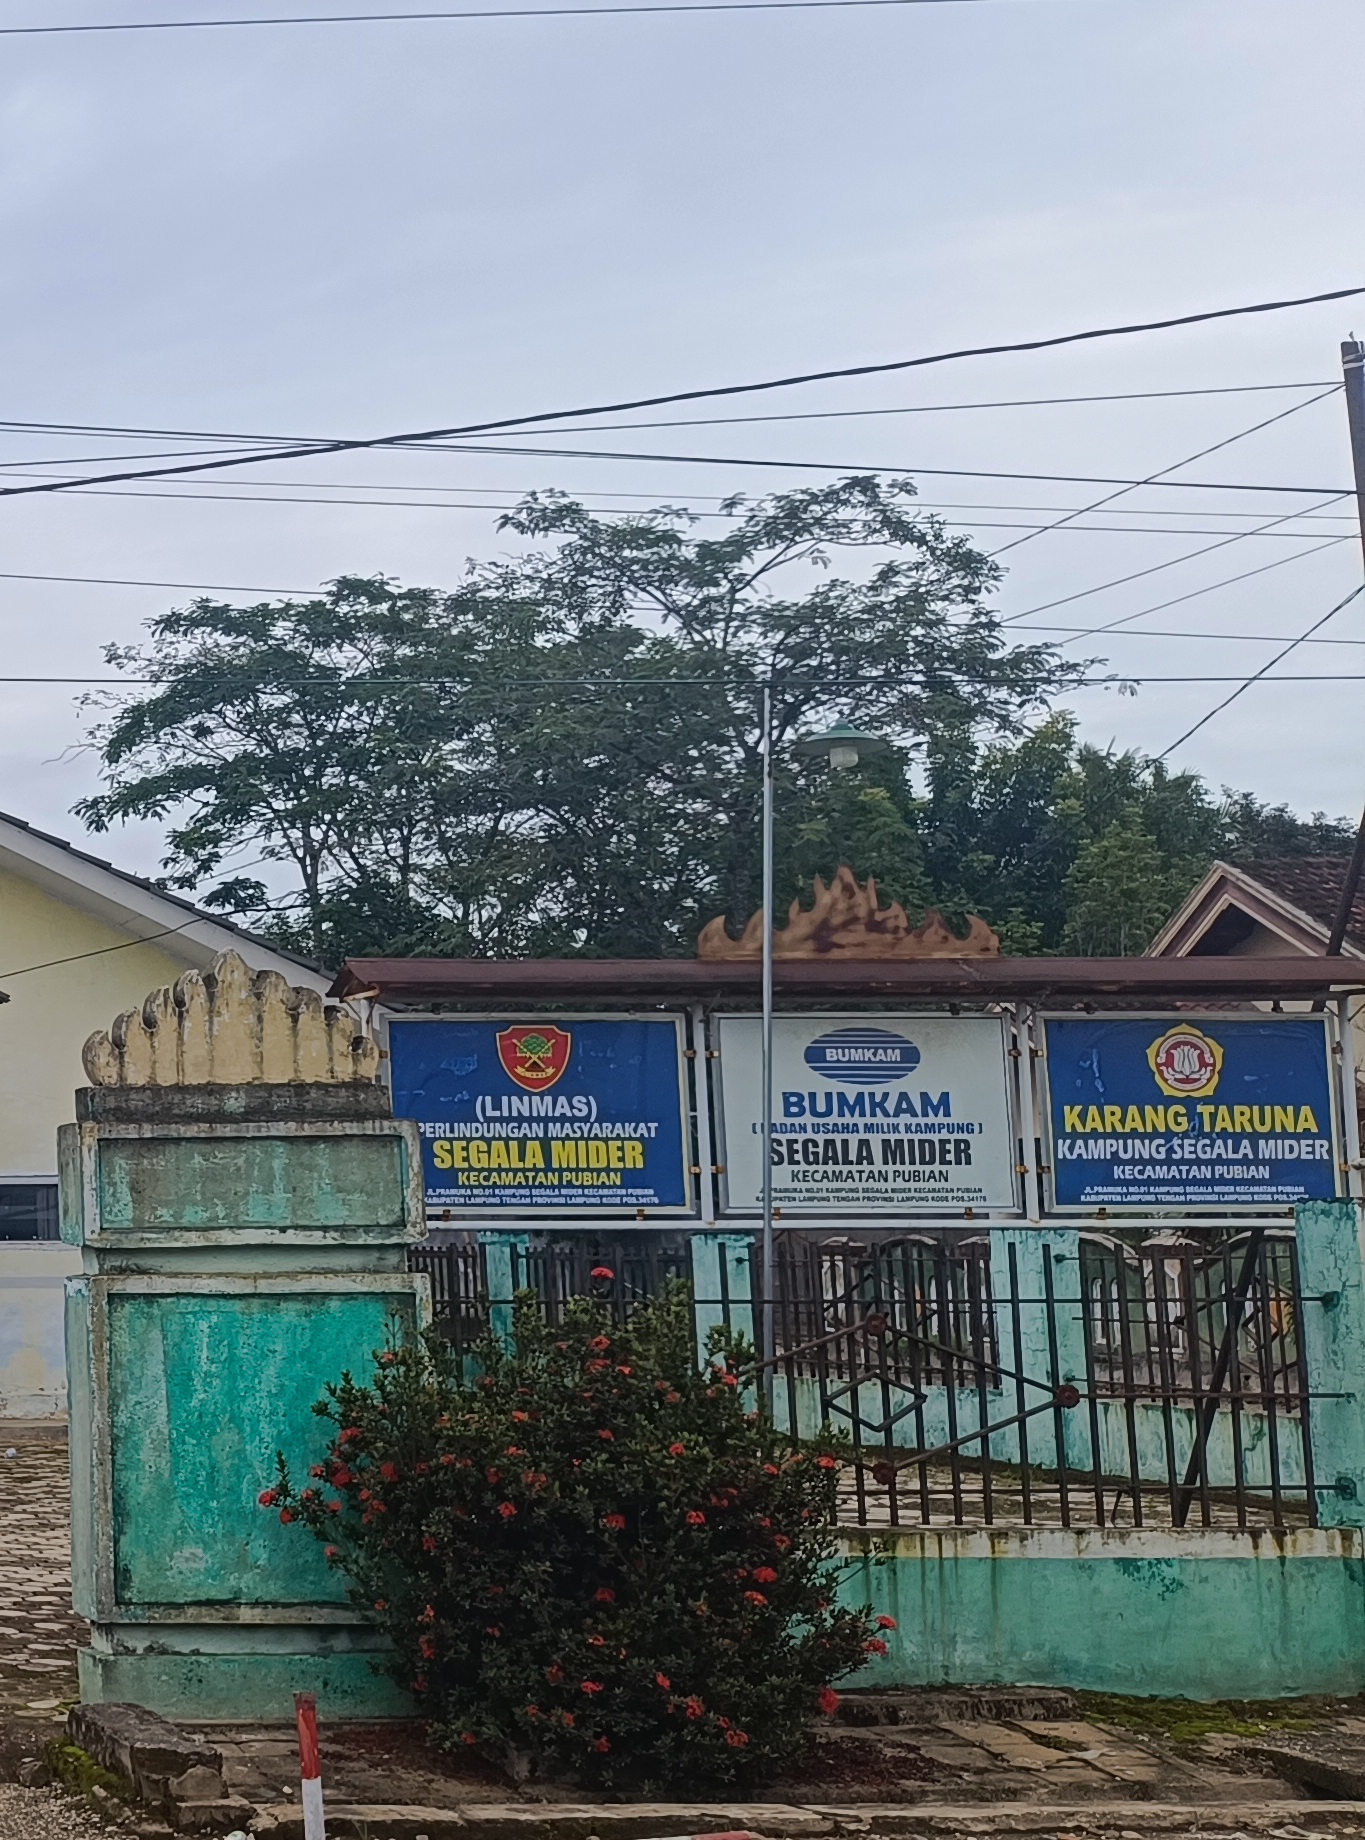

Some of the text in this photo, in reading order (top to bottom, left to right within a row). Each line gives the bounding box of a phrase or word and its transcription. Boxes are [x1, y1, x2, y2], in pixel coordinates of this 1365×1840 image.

[825, 1049, 901, 1061] BUMKAM
[476, 1095, 597, 1122] (LINMAS)
[782, 1092, 951, 1118] BUMKAM
[1064, 1105, 1318, 1133] KARANG TARUNA
[547, 1123, 658, 1137] MASYARAKAT
[811, 1123, 859, 1134] USAHA
[864, 1123, 901, 1134] MILIK
[904, 1123, 974, 1134] KAMPUNG
[433, 1140, 644, 1169] SEGALA MIDER
[770, 1138, 971, 1166] SEGALA MIDER
[1058, 1139, 1329, 1159] KAMPUNG SEGALA MIDER
[458, 1172, 621, 1185] KECAMATAN PUBIAN
[791, 1170, 949, 1182] KECAMATAN PUBIAN
[1114, 1166, 1269, 1179] KECAMATAN PUBIAN
